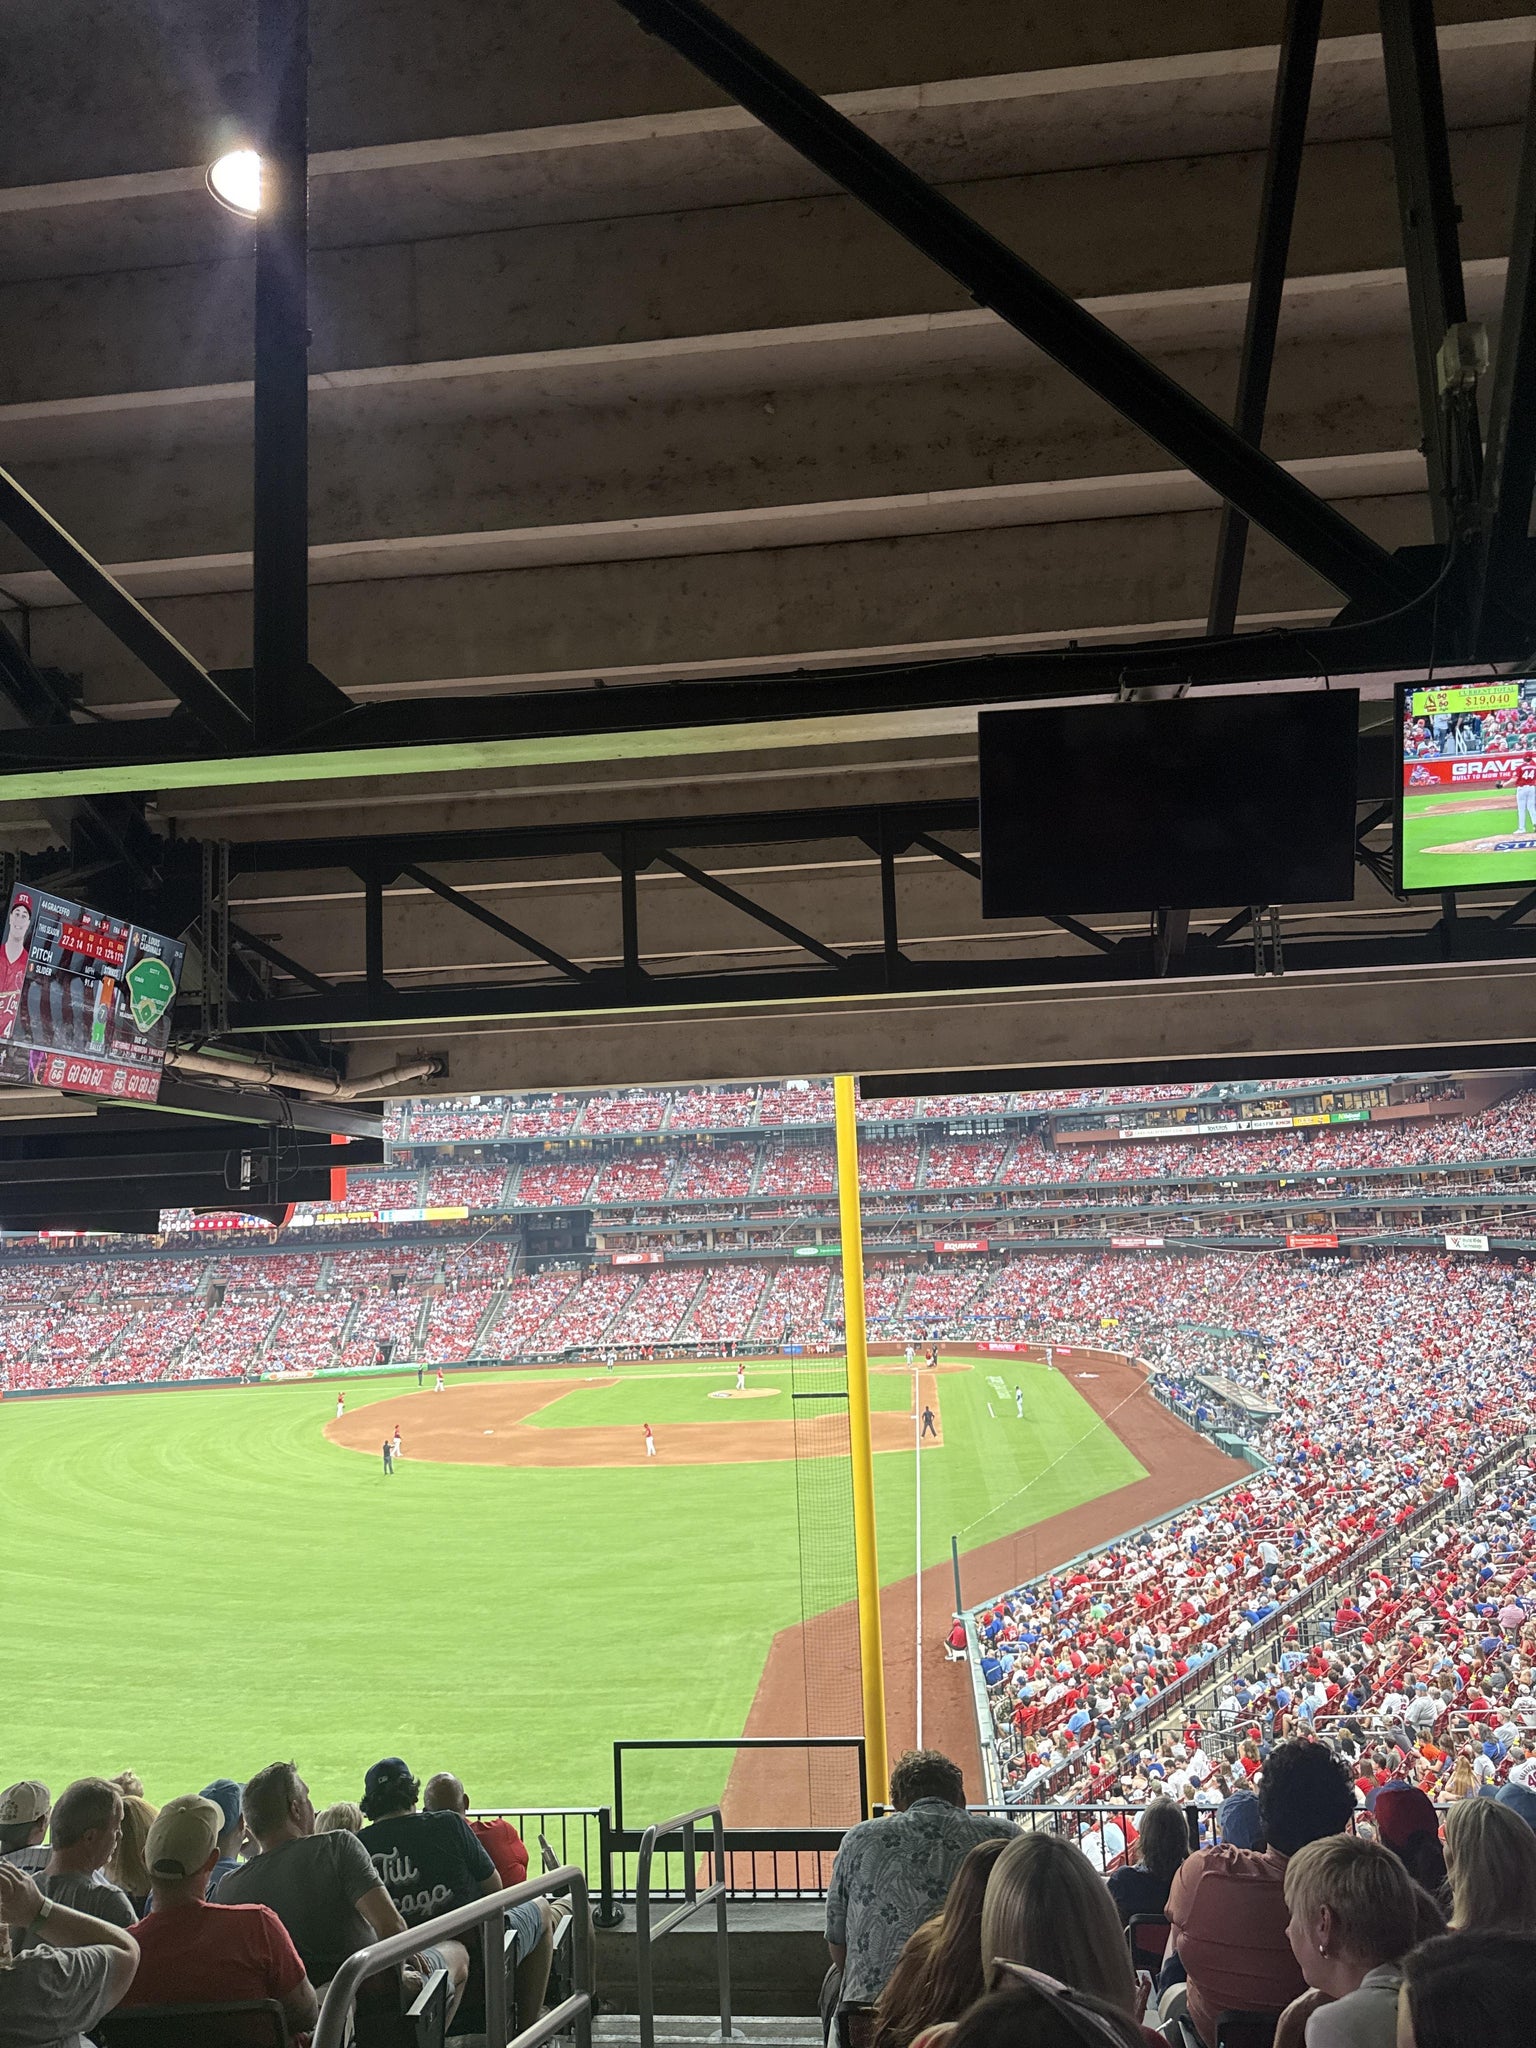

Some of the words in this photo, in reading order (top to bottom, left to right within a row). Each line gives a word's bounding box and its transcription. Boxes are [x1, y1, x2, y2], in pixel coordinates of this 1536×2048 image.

[1465, 694, 1510, 707] $19,040
[1521, 769, 1535, 780] 44
[19, 894, 30, 904] STL
[48, 902, 70, 917] GRACEFFO
[39, 922, 48, 932] THIS
[47, 925, 60, 936] SEASON
[61, 935, 74, 947] 27.2
[76, 939, 83, 950] 14
[86, 943, 93, 953] 11
[96, 946, 103, 956] 12
[104, 948, 114, 960] 12%
[148, 935, 160, 947] LOUIS
[31, 946, 54, 963] PITCH
[139, 942, 162, 956] CARDINALS
[36, 965, 53, 977] SLIDER
[51, 1069, 61, 1080] 66
[67, 1064, 79, 1083] GO
[79, 1066, 91, 1084] GO
[91, 1068, 103, 1087] GO
[113, 1080, 123, 1091] 66
[128, 1074, 139, 1092] GO
[138, 1076, 149, 1093] GO
[943, 1242, 979, 1251] EQUIFAX
